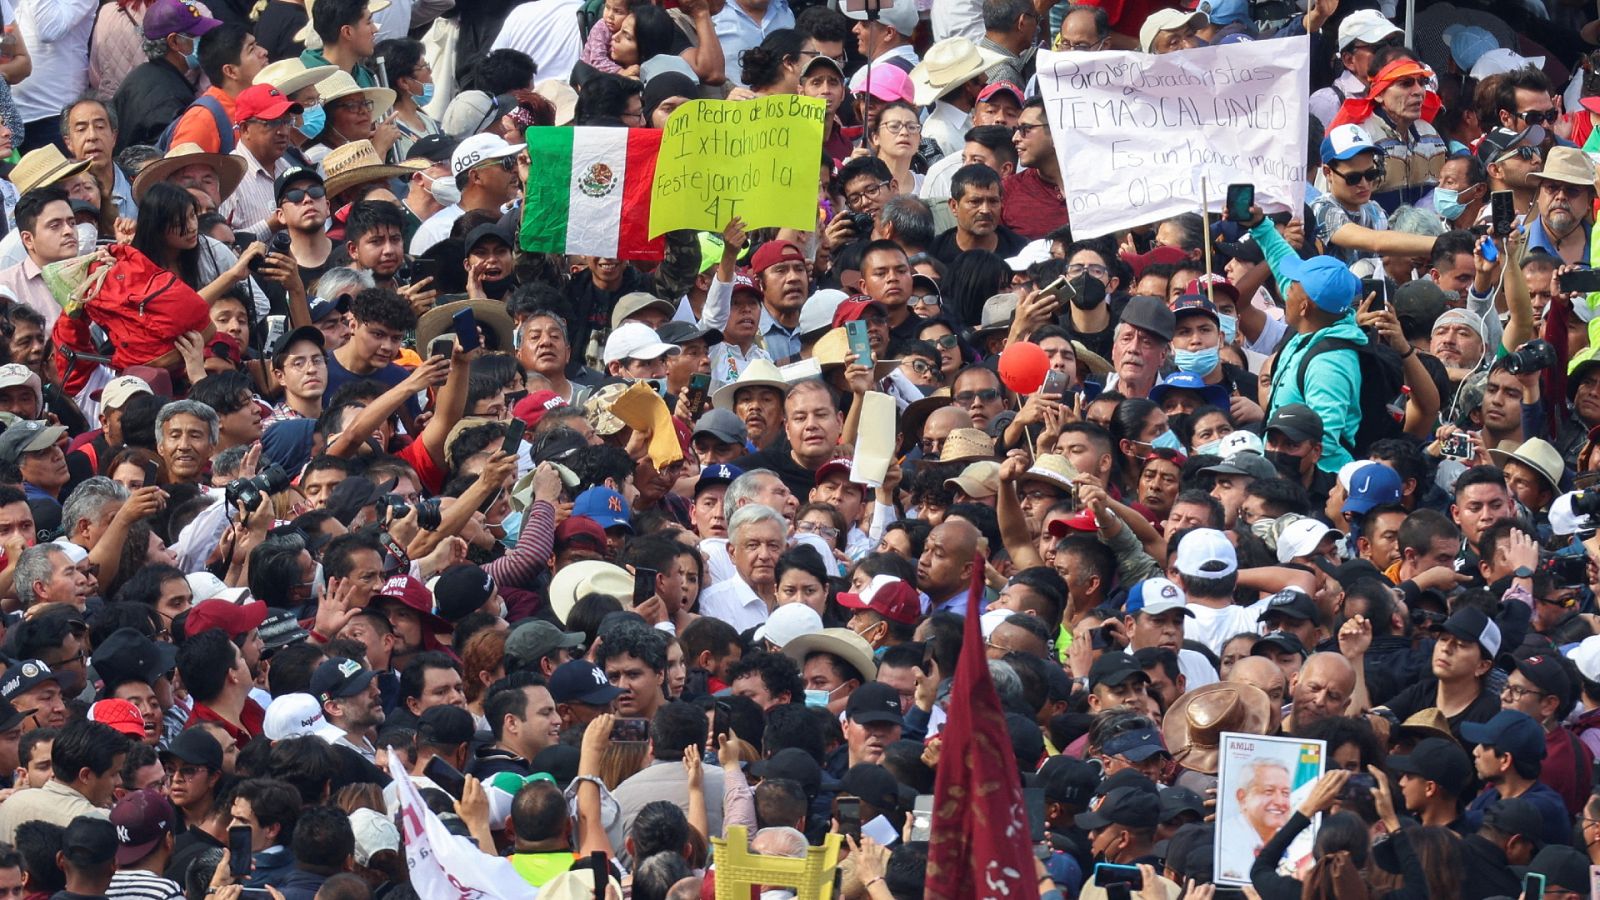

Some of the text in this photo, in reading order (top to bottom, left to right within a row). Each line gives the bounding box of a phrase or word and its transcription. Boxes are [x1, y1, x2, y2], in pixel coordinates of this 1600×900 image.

[1053, 56, 1275, 92] Para los Obradoristas
[697, 100, 741, 124] Pedro
[750, 106, 761, 121] de
[765, 99, 784, 119] los
[1048, 93, 1287, 130] TEMASCALCINGO
[454, 150, 481, 173] das
[1112, 138, 1307, 182] Es un honor marchar
[657, 158, 793, 202] Festejando la
[718, 465, 732, 479] LA
[1358, 475, 1371, 493] J
